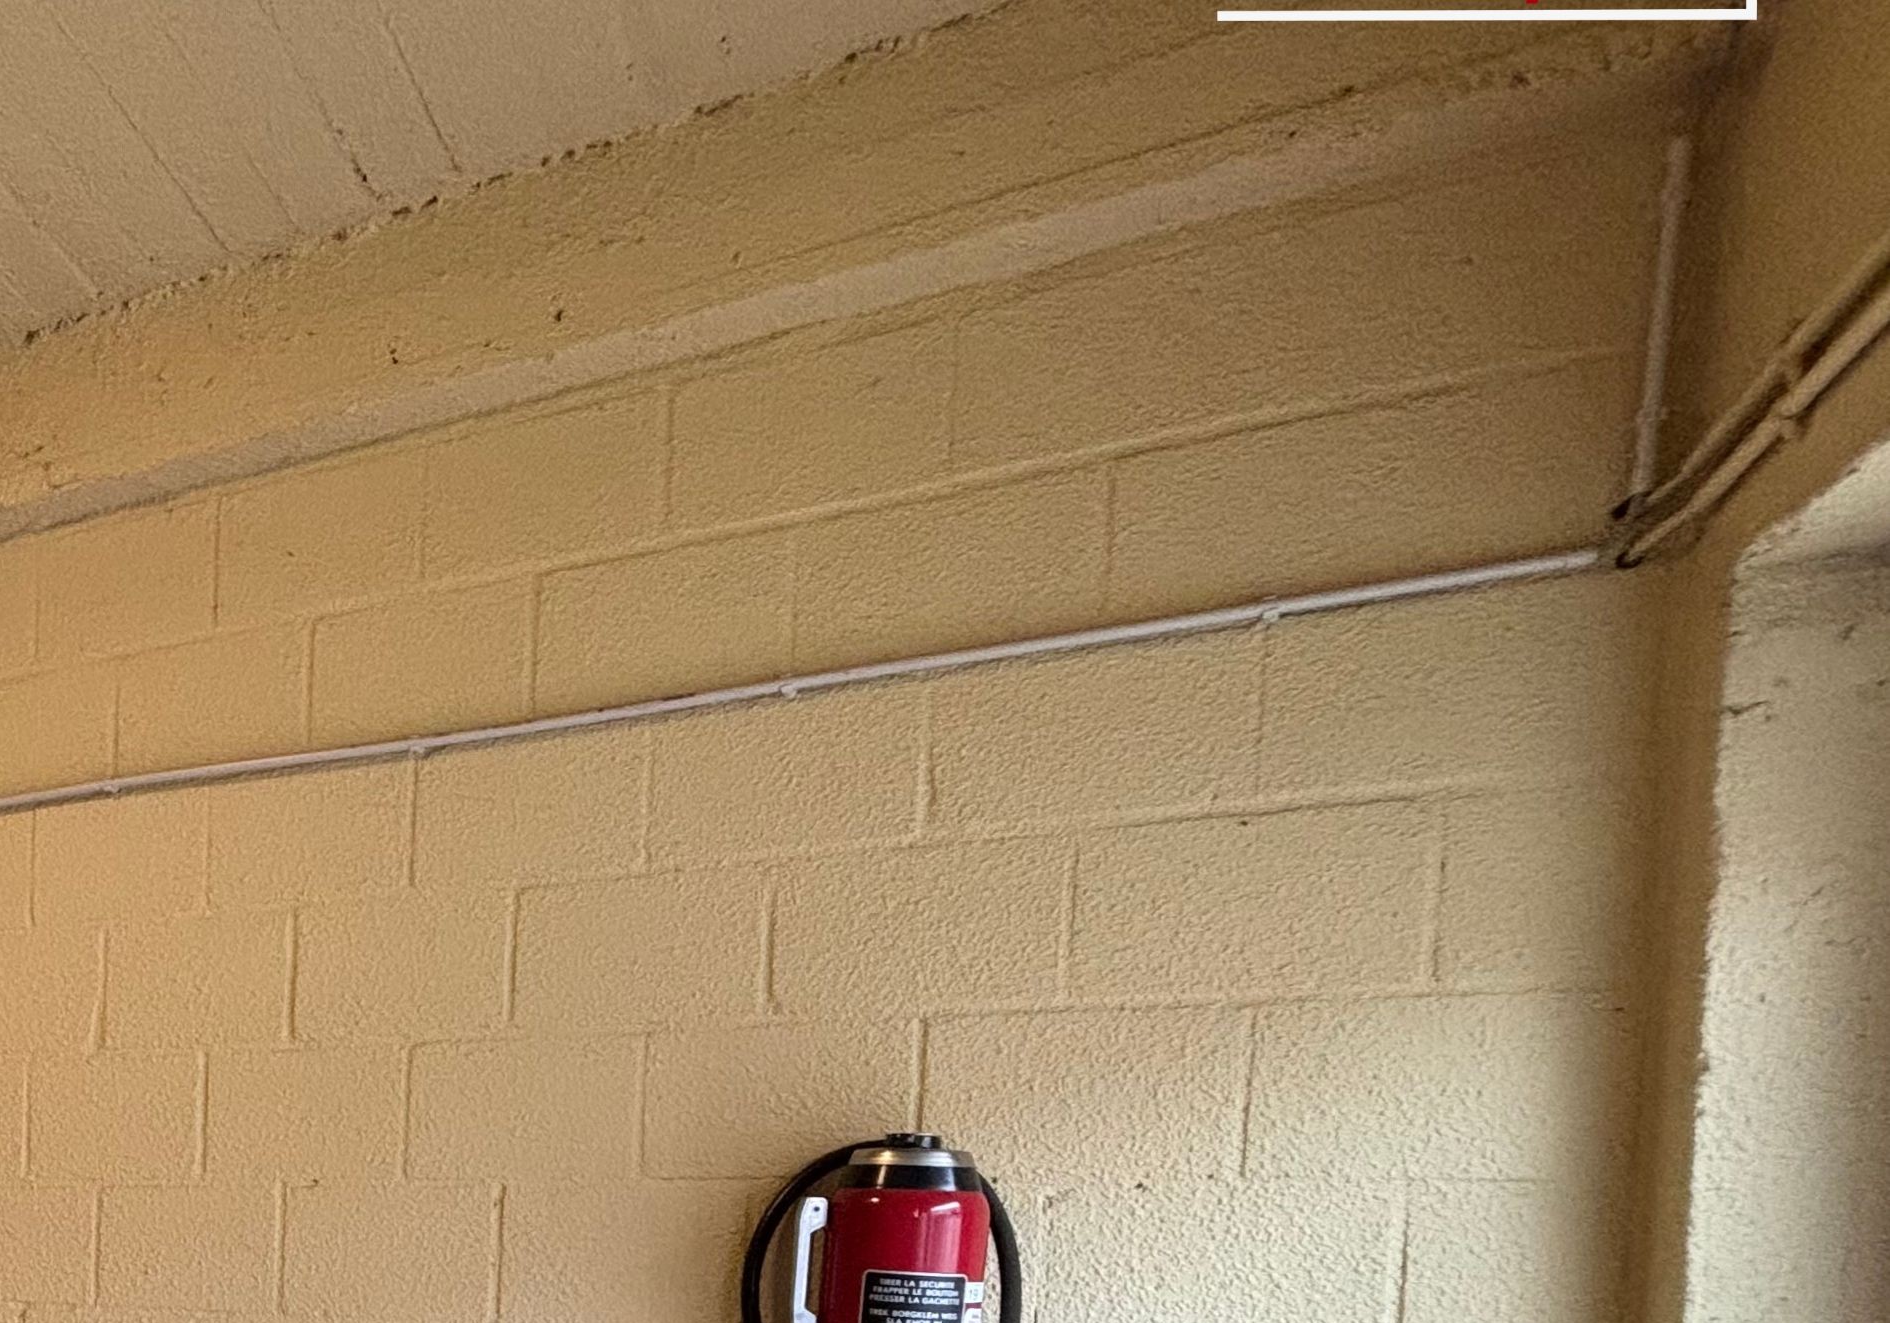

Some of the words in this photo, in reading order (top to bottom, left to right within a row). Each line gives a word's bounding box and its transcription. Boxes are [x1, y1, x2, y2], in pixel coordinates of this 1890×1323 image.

[872, 1286, 909, 1295] FRAPPER
[912, 1288, 922, 1296] LE
[868, 1294, 905, 1303] PRESSER
[908, 1296, 920, 1304] LA
